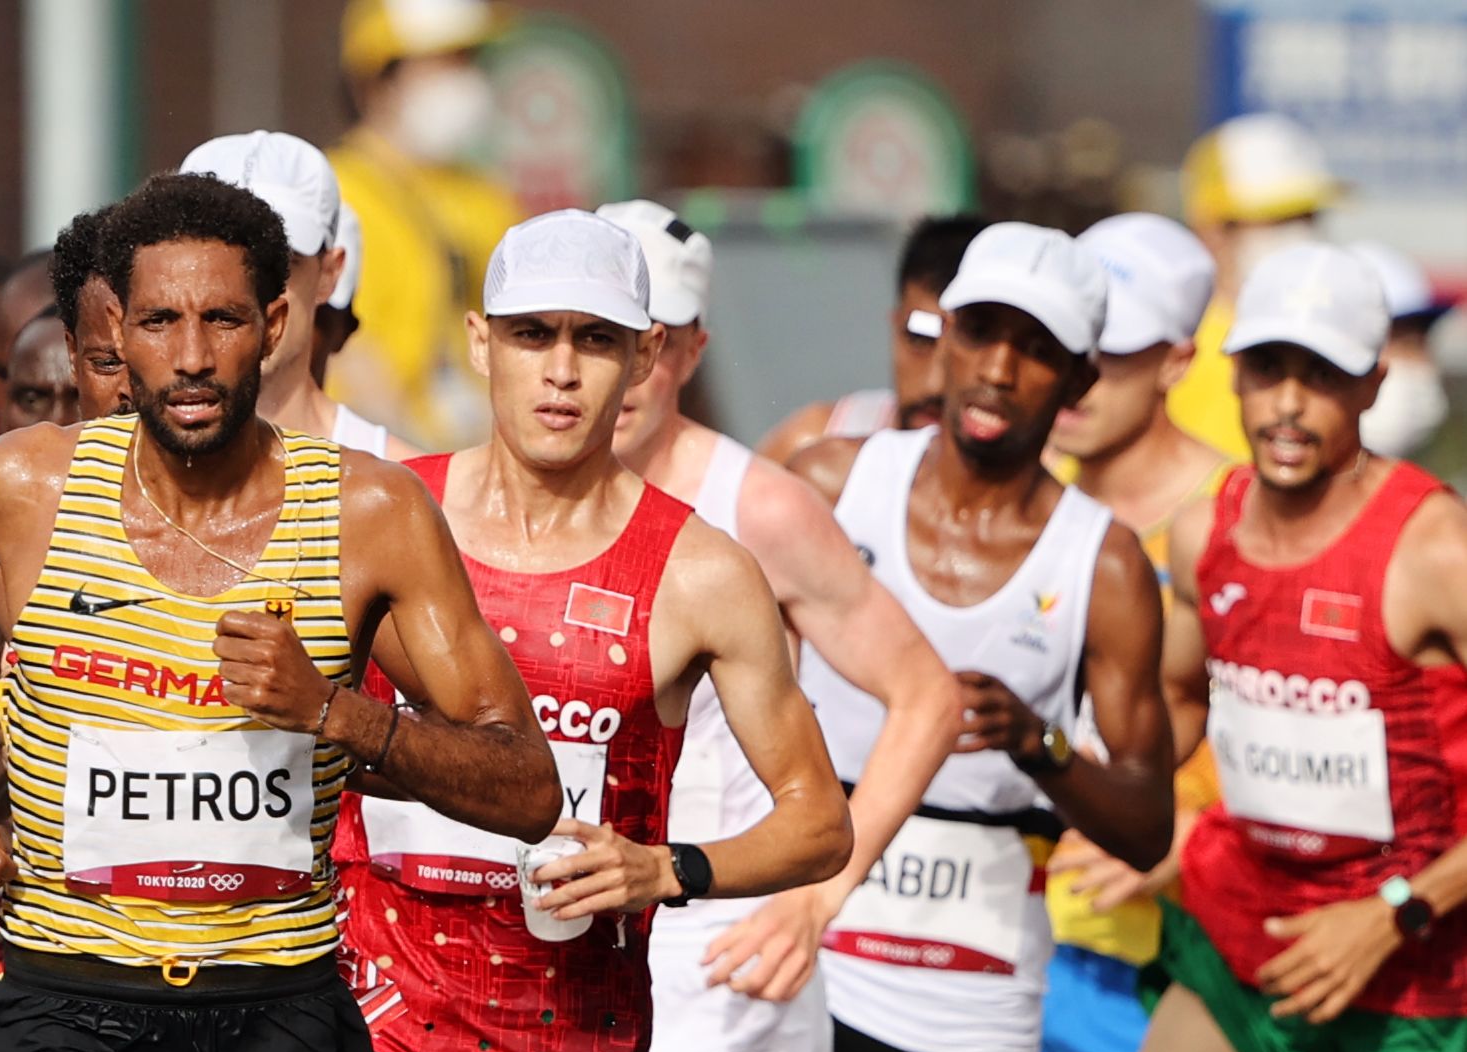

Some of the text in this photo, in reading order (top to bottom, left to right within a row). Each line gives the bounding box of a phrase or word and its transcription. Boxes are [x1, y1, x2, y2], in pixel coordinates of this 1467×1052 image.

[51, 644, 231, 707] GERMA
[531, 694, 622, 743] CCO
[1244, 742, 1369, 787] GOUMRI
[87, 767, 292, 822] PETROS
[136, 874, 205, 889] TOKYO 2020
[418, 864, 483, 884] TOKYO 2020
